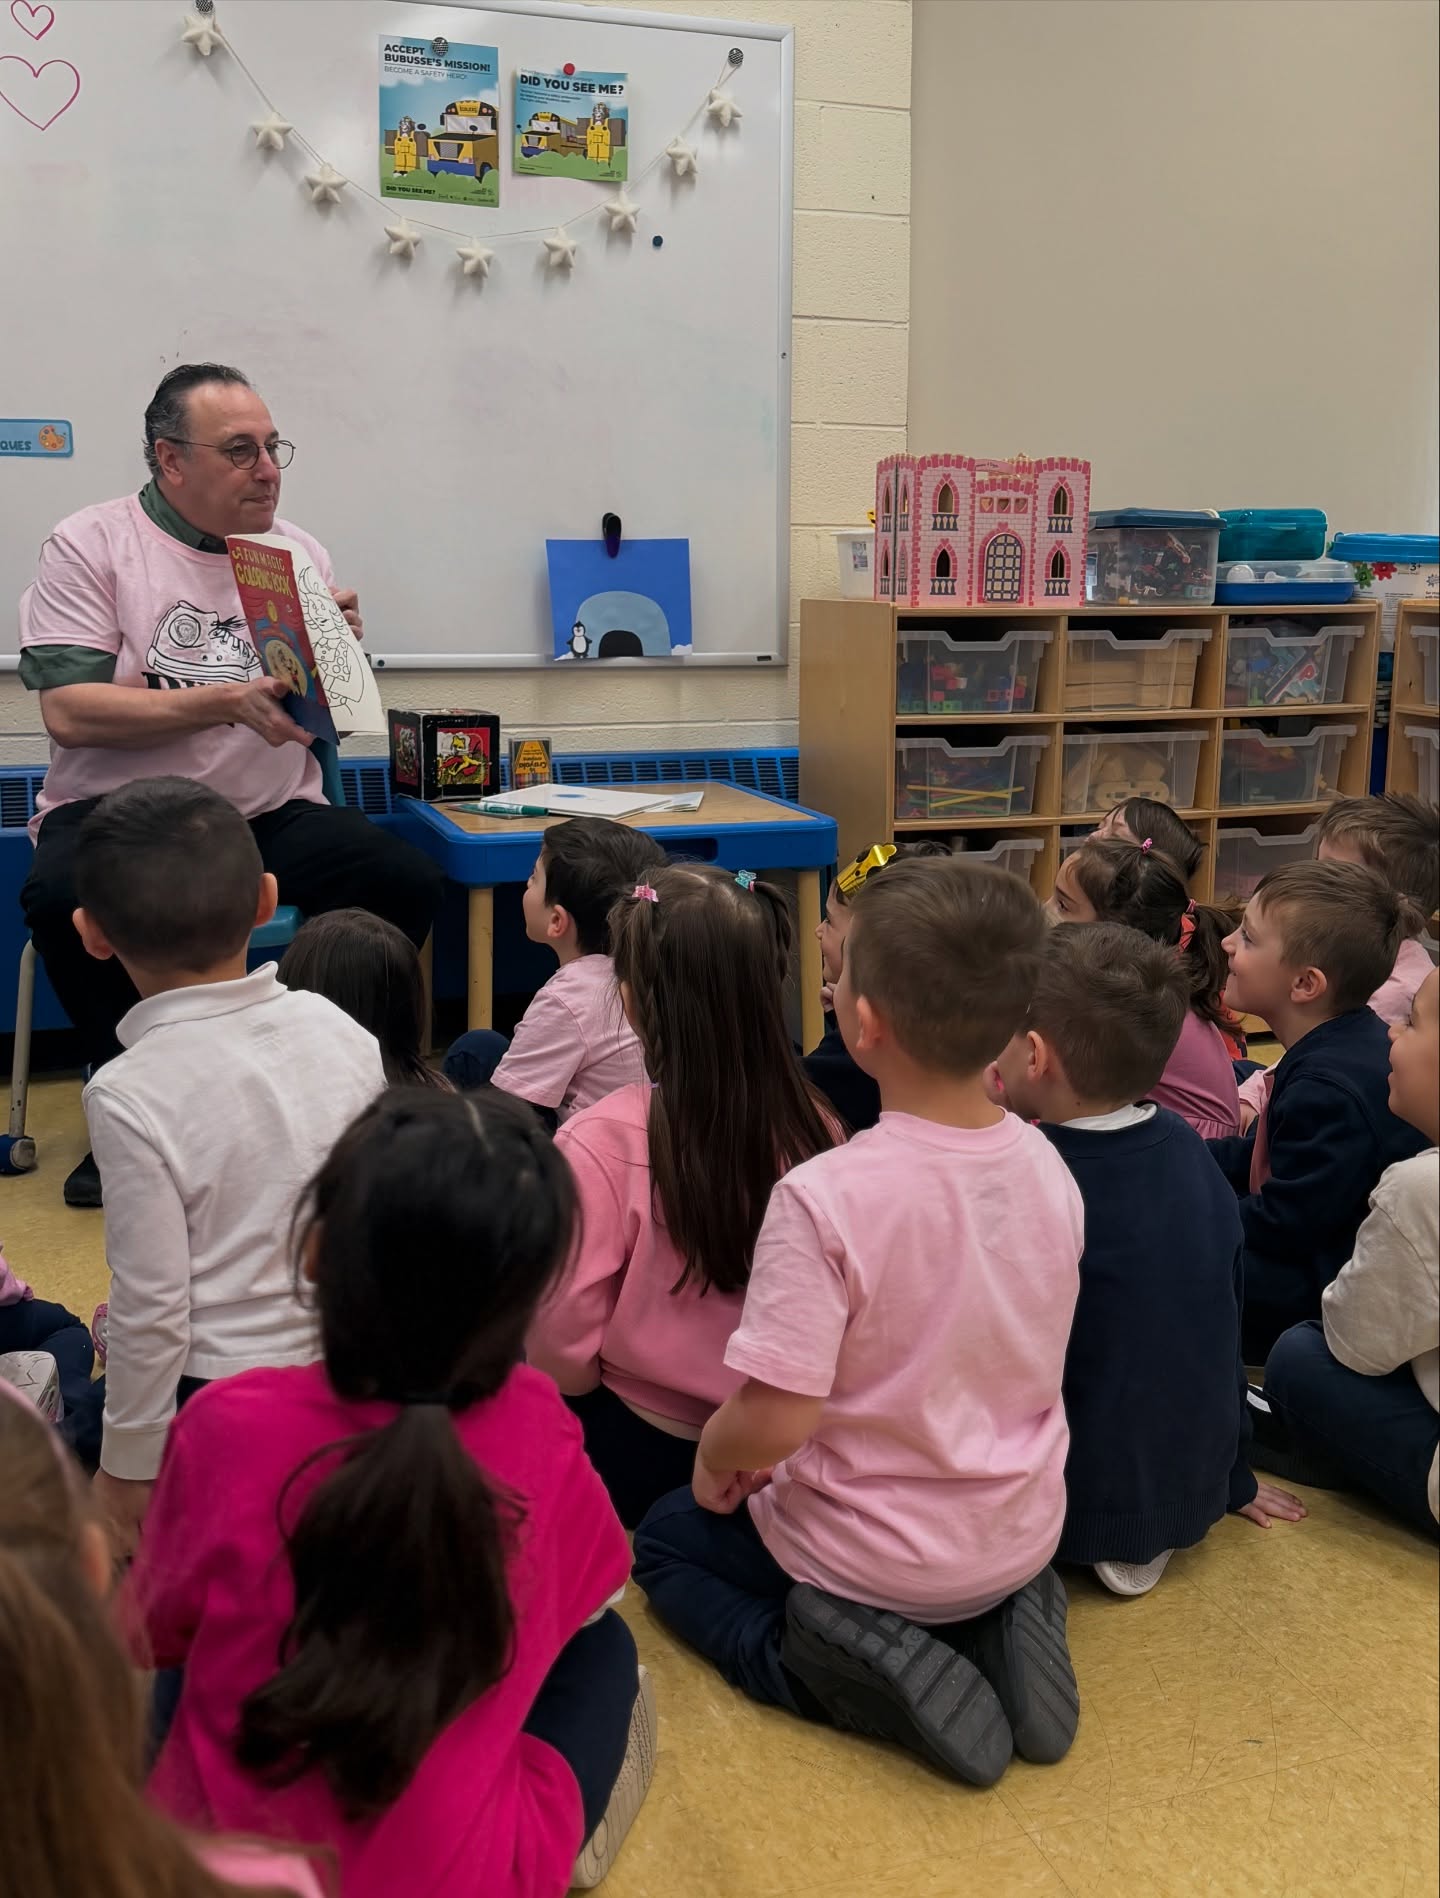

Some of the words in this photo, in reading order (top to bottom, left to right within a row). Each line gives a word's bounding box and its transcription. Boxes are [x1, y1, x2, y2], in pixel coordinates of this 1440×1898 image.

[384, 43, 425, 55] ACCEPT
[384, 53, 442, 66] BUBUSSE'S
[444, 59, 491, 72] MISSION!
[384, 66, 413, 75] BECOME
[420, 69, 445, 78] SAFETY
[520, 74, 540, 86] DID
[543, 78, 570, 90] YOU
[572, 82, 596, 93] SEE
[598, 84, 624, 95] ME?
[0, 440, 32, 451] QUES
